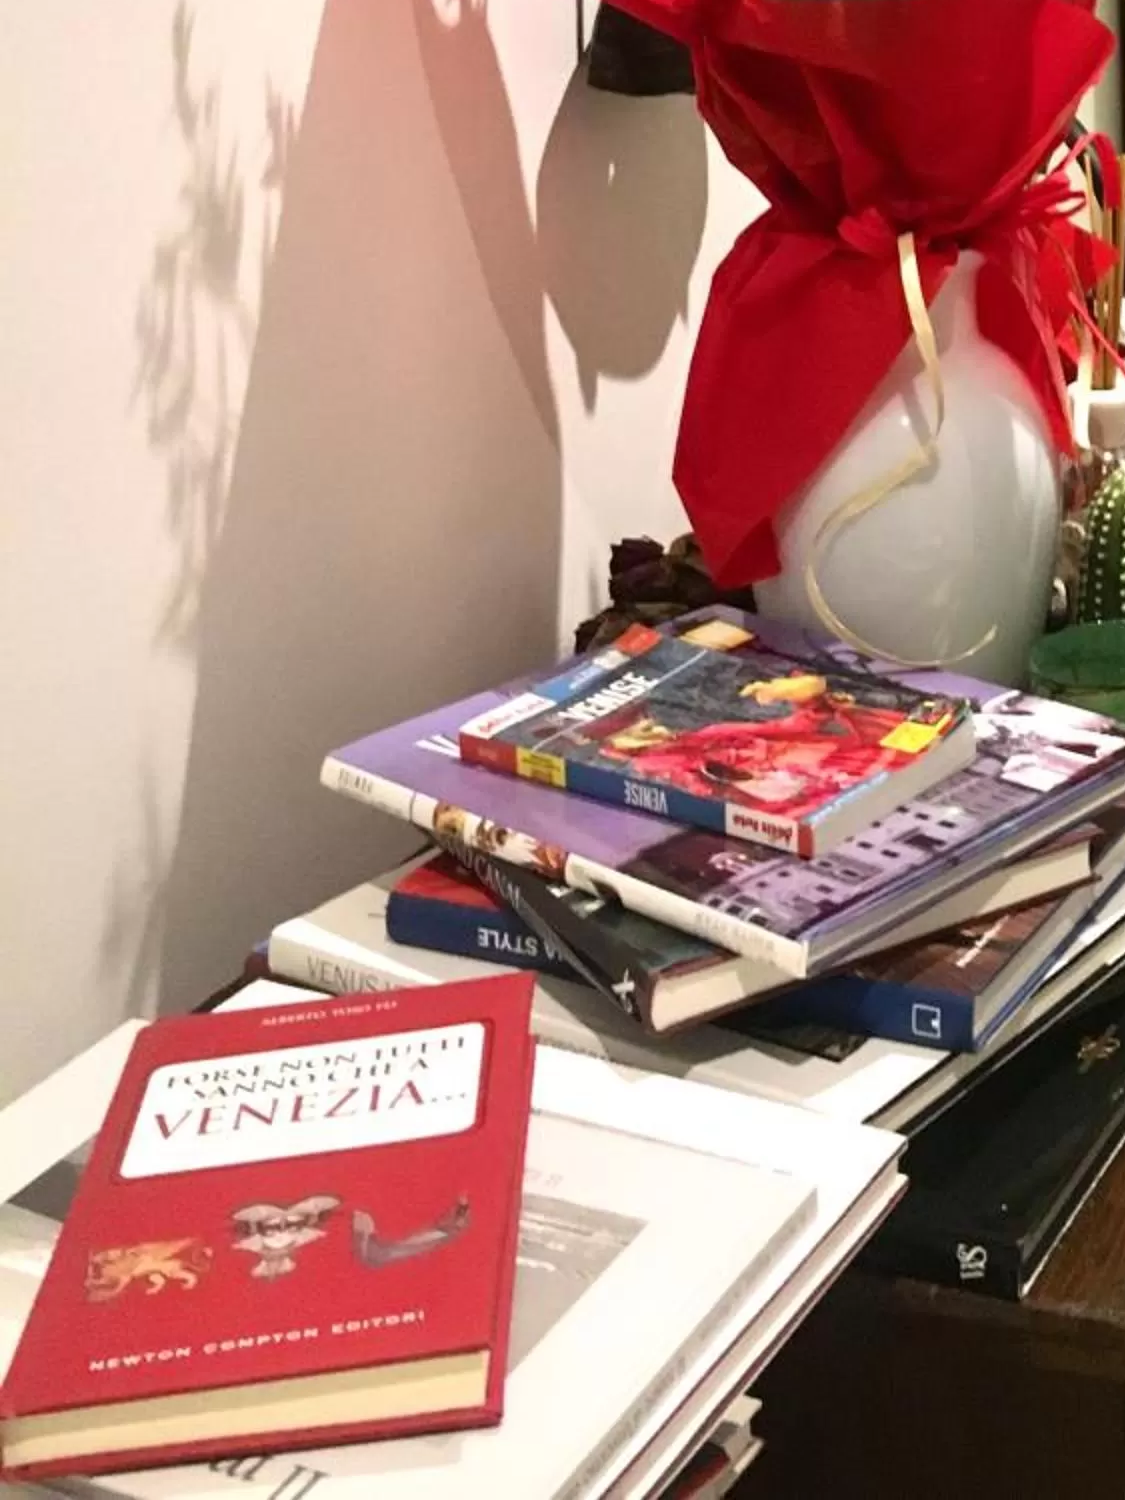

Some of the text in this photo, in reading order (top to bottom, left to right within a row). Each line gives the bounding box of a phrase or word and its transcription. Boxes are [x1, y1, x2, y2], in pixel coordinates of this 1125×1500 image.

[558, 671, 660, 722] VENISE
[623, 779, 669, 815] VENISE
[477, 926, 538, 957] STYLE
[306, 955, 380, 996] VENUS
[279, 1052, 357, 1073] NON
[410, 1057, 430, 1073] A
[88, 1309, 426, 1372] NEWTON COMPTON EDITORI
